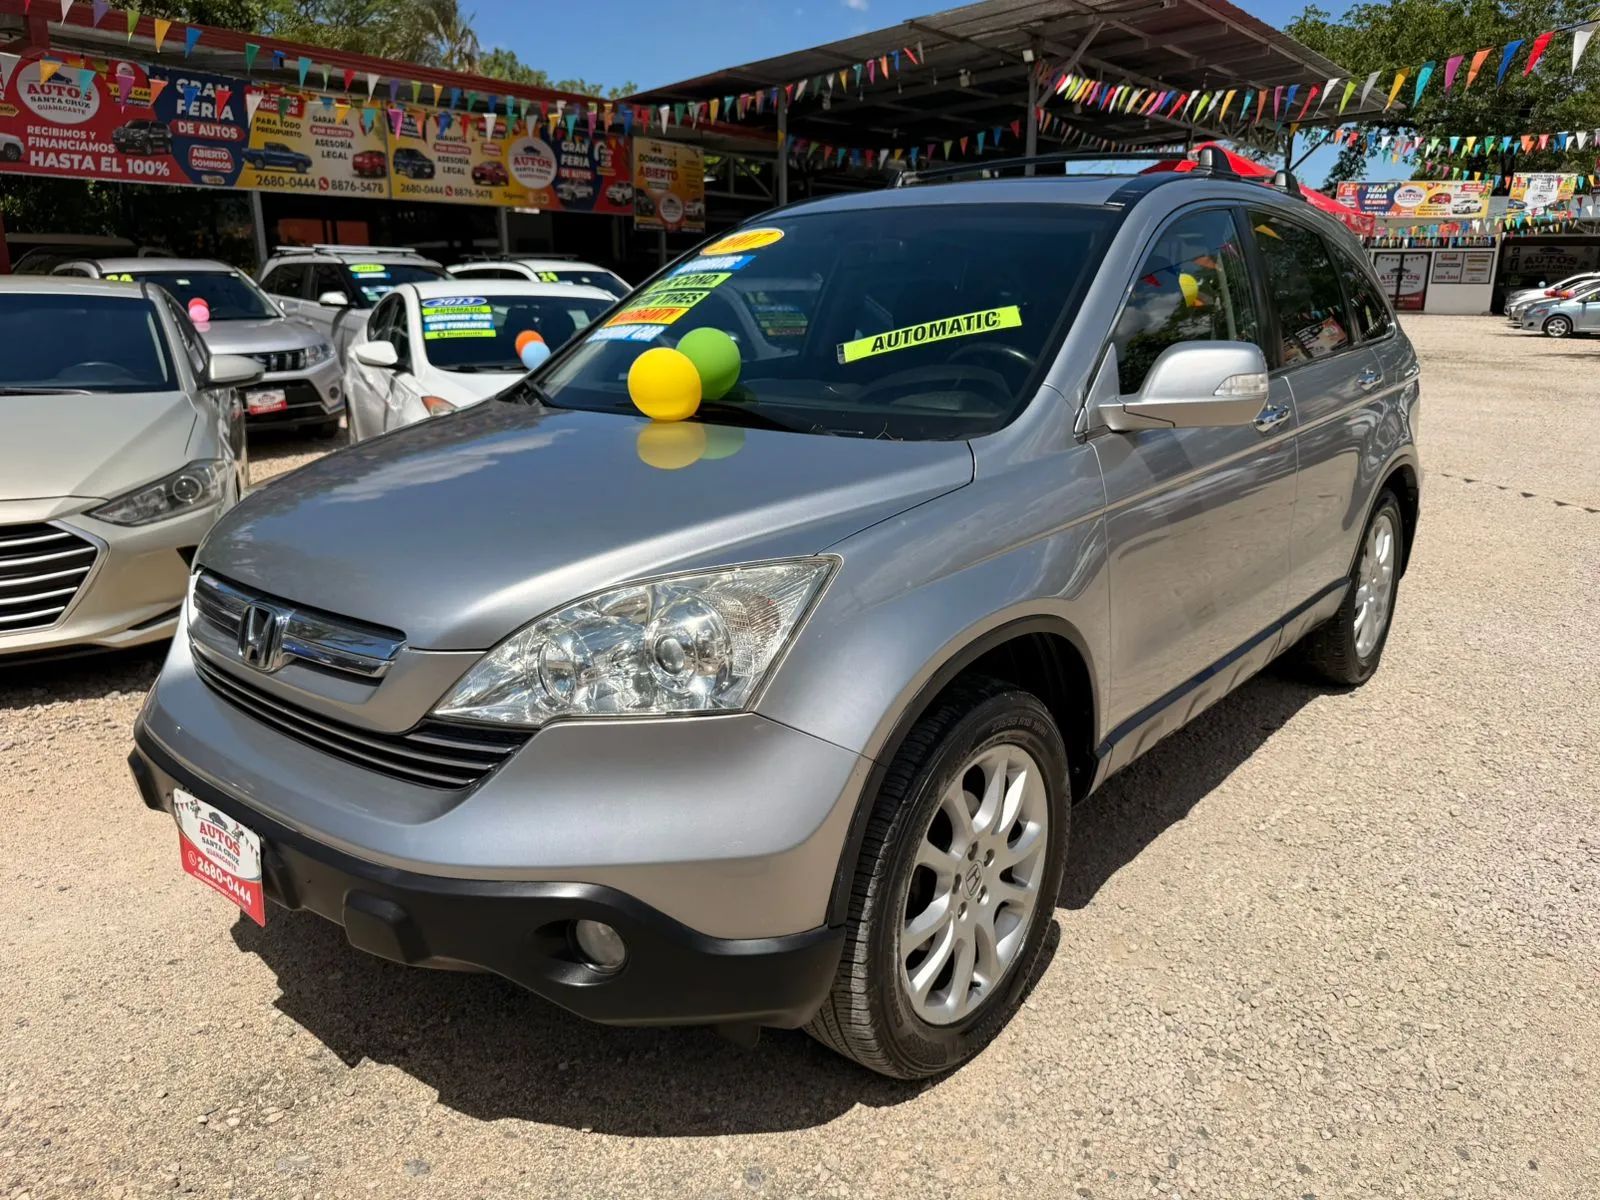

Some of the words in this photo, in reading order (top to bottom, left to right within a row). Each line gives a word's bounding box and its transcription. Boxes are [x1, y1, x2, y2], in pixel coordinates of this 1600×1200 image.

[27, 83, 92, 101] AUTOS
[30, 96, 63, 104] SANTA
[65, 99, 91, 109] CRUZ
[256, 117, 277, 126] PARA
[280, 120, 301, 130] TODO
[27, 125, 87, 139] RECIBIMOS
[89, 131, 96, 140] Y
[178, 122, 194, 134] DE
[199, 125, 238, 139] AUTOS
[256, 126, 302, 138] PRESUPUESTO
[28, 136, 116, 154] FINANCIAMOS
[315, 138, 352, 149] ASESORÍA
[561, 141, 589, 154] GRAN
[192, 148, 229, 160] ABIERTO
[322, 150, 349, 160] LEGAL
[30, 151, 95, 171] HASTA
[101, 156, 122, 173] EL
[126, 158, 170, 177] 100%
[192, 158, 231, 169] DOMINGOS
[514, 156, 553, 169] AUTOS
[561, 154, 590, 168] FERIA
[638, 166, 679, 181] ABIERTO
[256, 174, 316, 189] 2680-0444
[1524, 255, 1578, 265] AUTOS
[440, 297, 475, 306] 2013
[434, 306, 482, 314] AUTOMATIC
[871, 311, 1000, 352] AUTOMATIC
[200, 822, 241, 857] AUTOS
[202, 836, 222, 853] SANTA
[223, 846, 240, 866] CRUZ
[197, 857, 252, 905] 2680-0444
